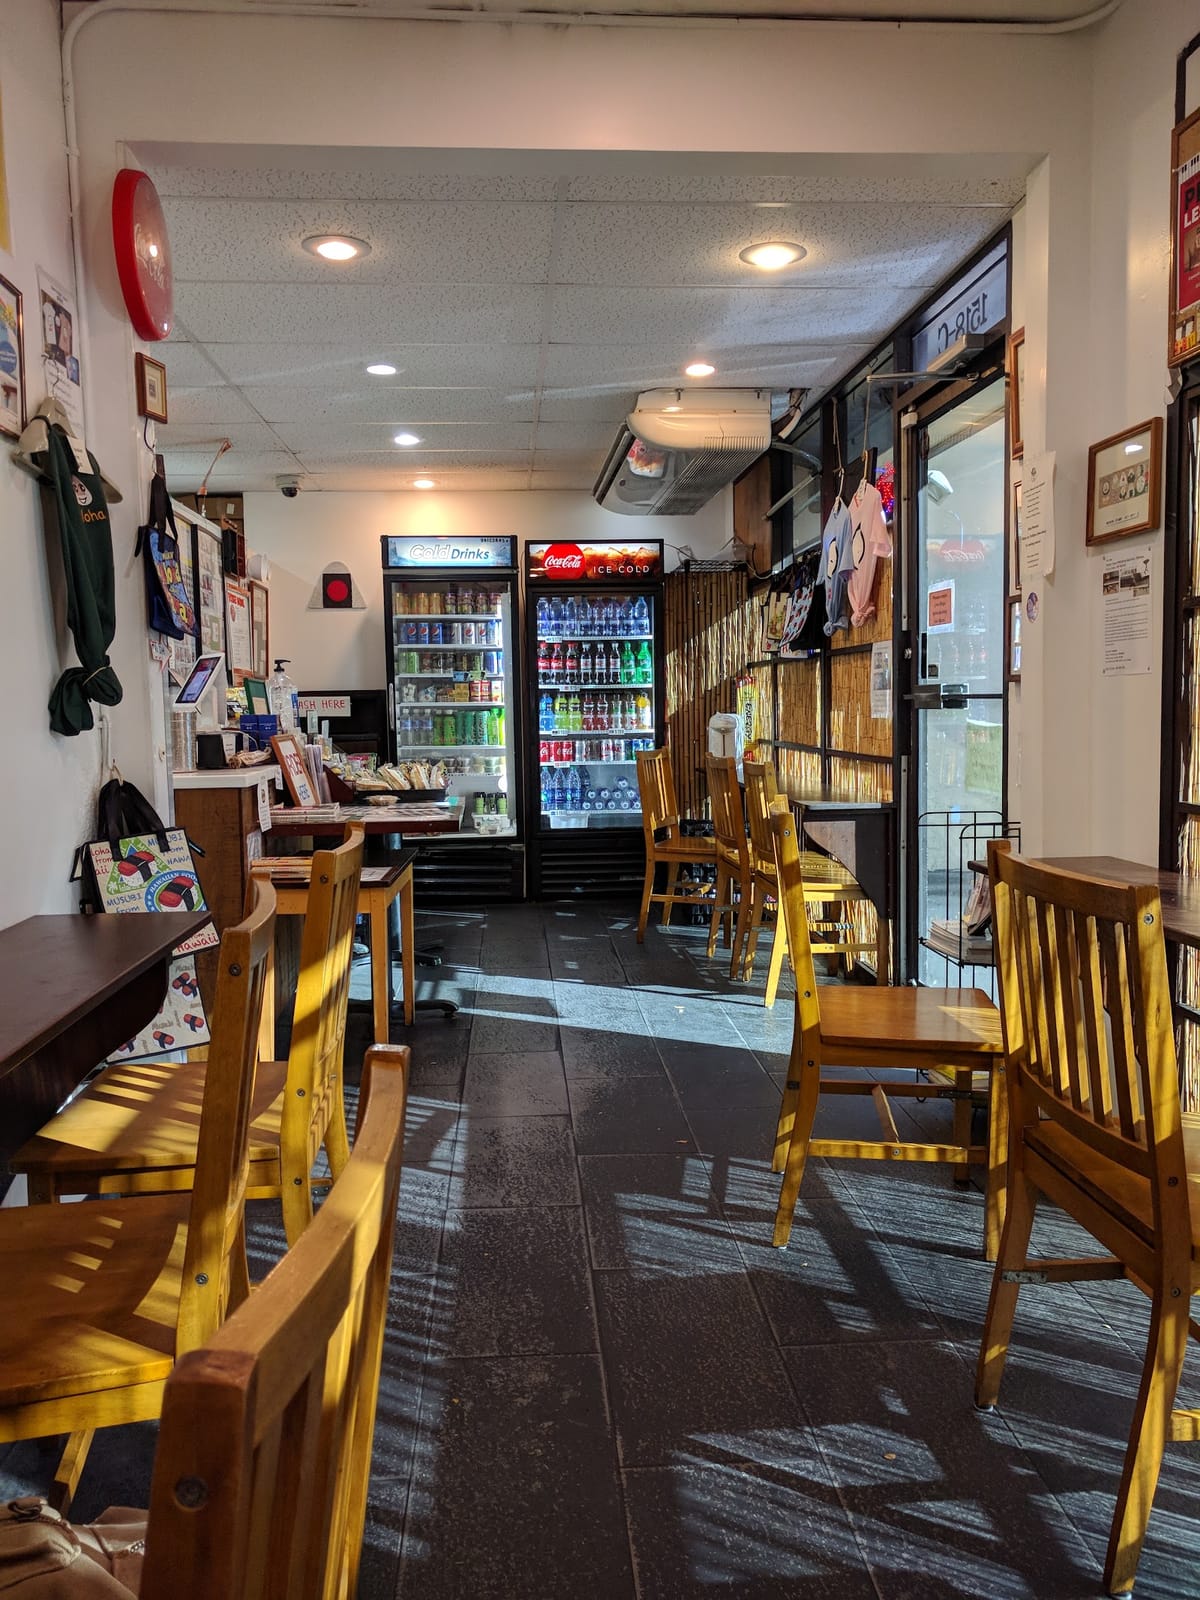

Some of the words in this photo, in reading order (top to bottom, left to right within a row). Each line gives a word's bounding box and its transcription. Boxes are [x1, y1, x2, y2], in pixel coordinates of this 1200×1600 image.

[81, 509, 107, 523] loha
[410, 544, 451, 560] Cold
[451, 548, 490, 559] Drinks
[544, 554, 583, 569] Coca-Cola
[593, 565, 612, 574] ICE
[618, 564, 650, 574] COLD
[297, 700, 316, 710] ASH
[321, 699, 346, 709] HERE
[106, 894, 143, 906] MUSUBI
